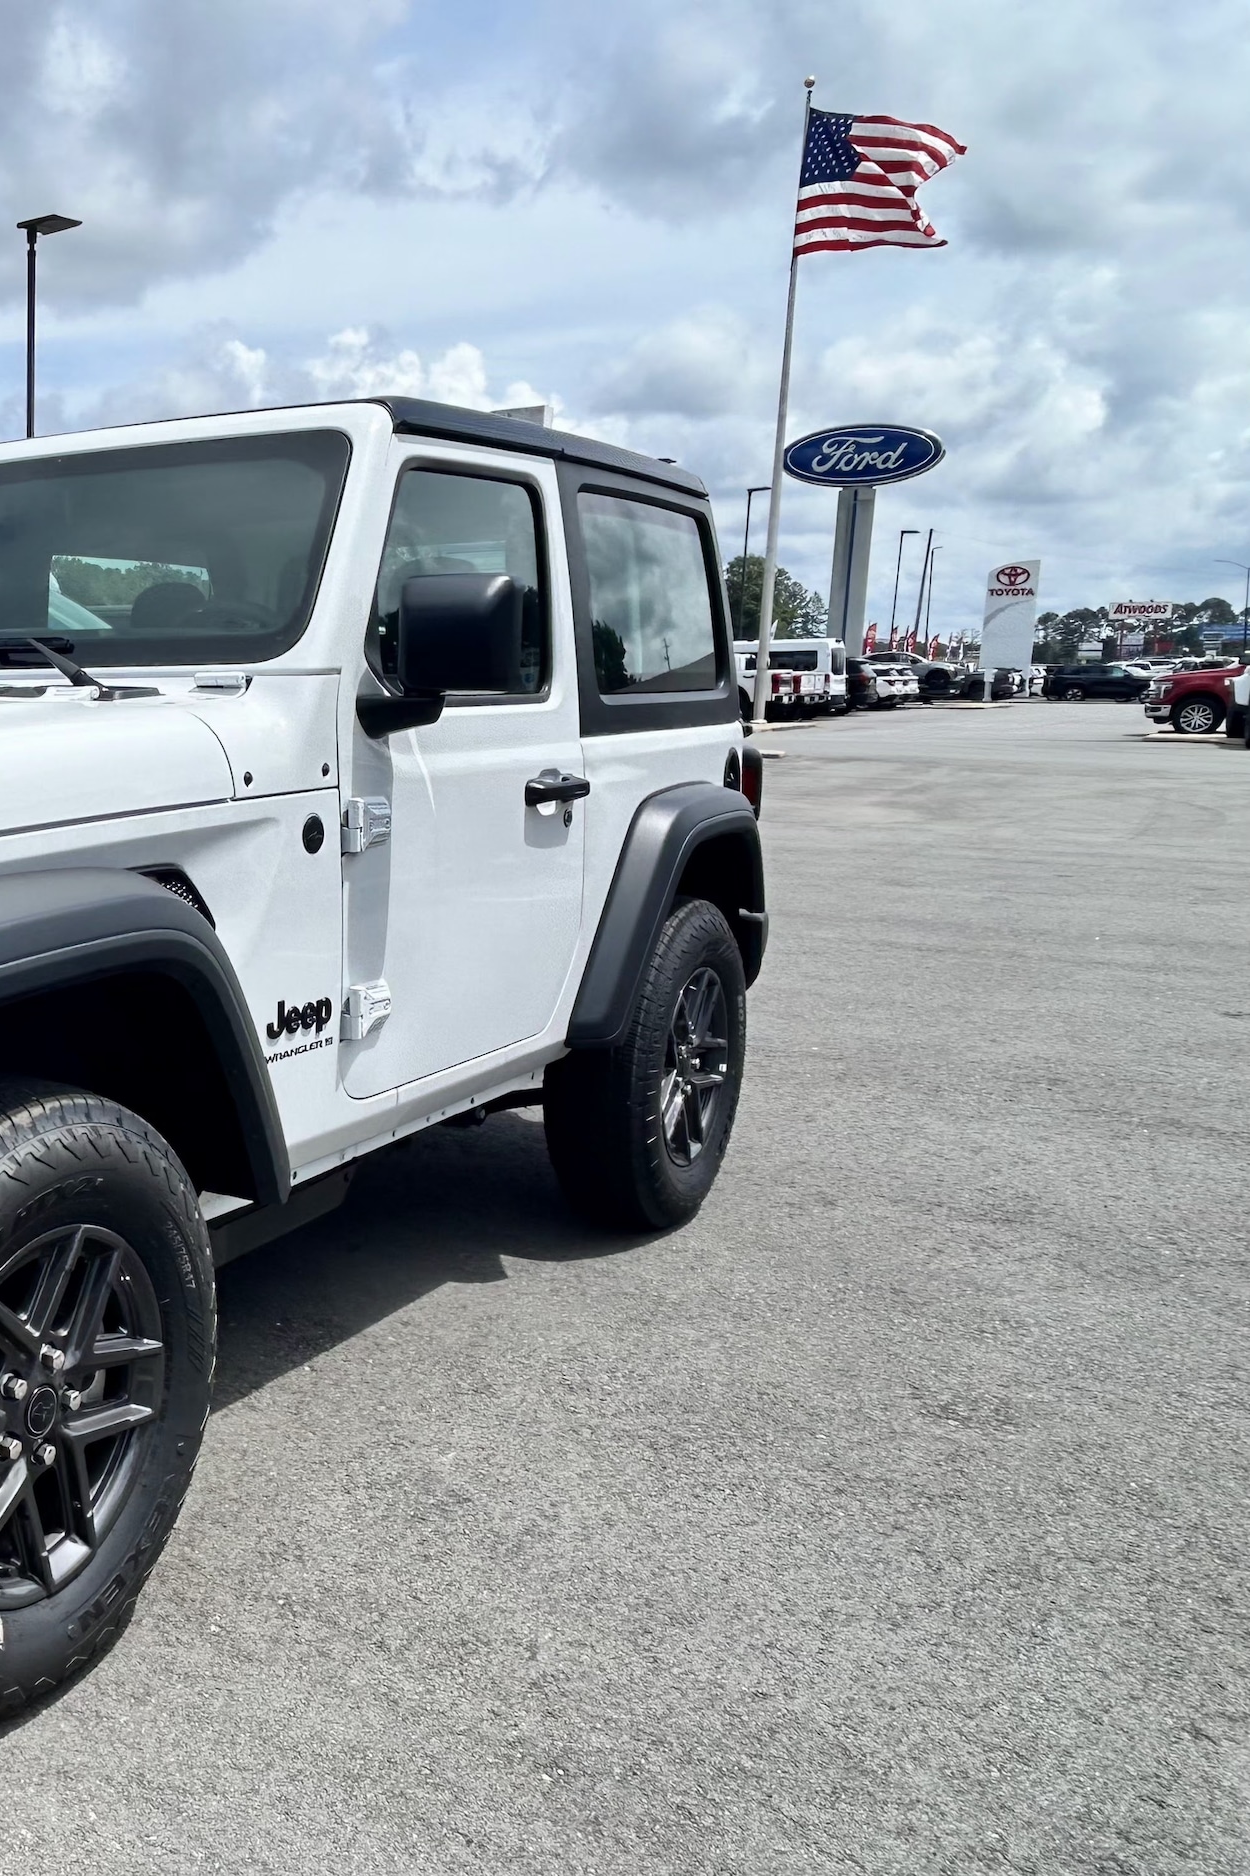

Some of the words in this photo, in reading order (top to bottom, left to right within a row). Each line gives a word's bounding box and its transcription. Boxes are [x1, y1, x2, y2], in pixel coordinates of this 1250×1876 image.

[811, 436, 909, 473] Ford
[988, 587, 1035, 597] TOYOTA
[266, 997, 333, 1040] Jeep
[264, 1040, 323, 1064] WRANGLER
